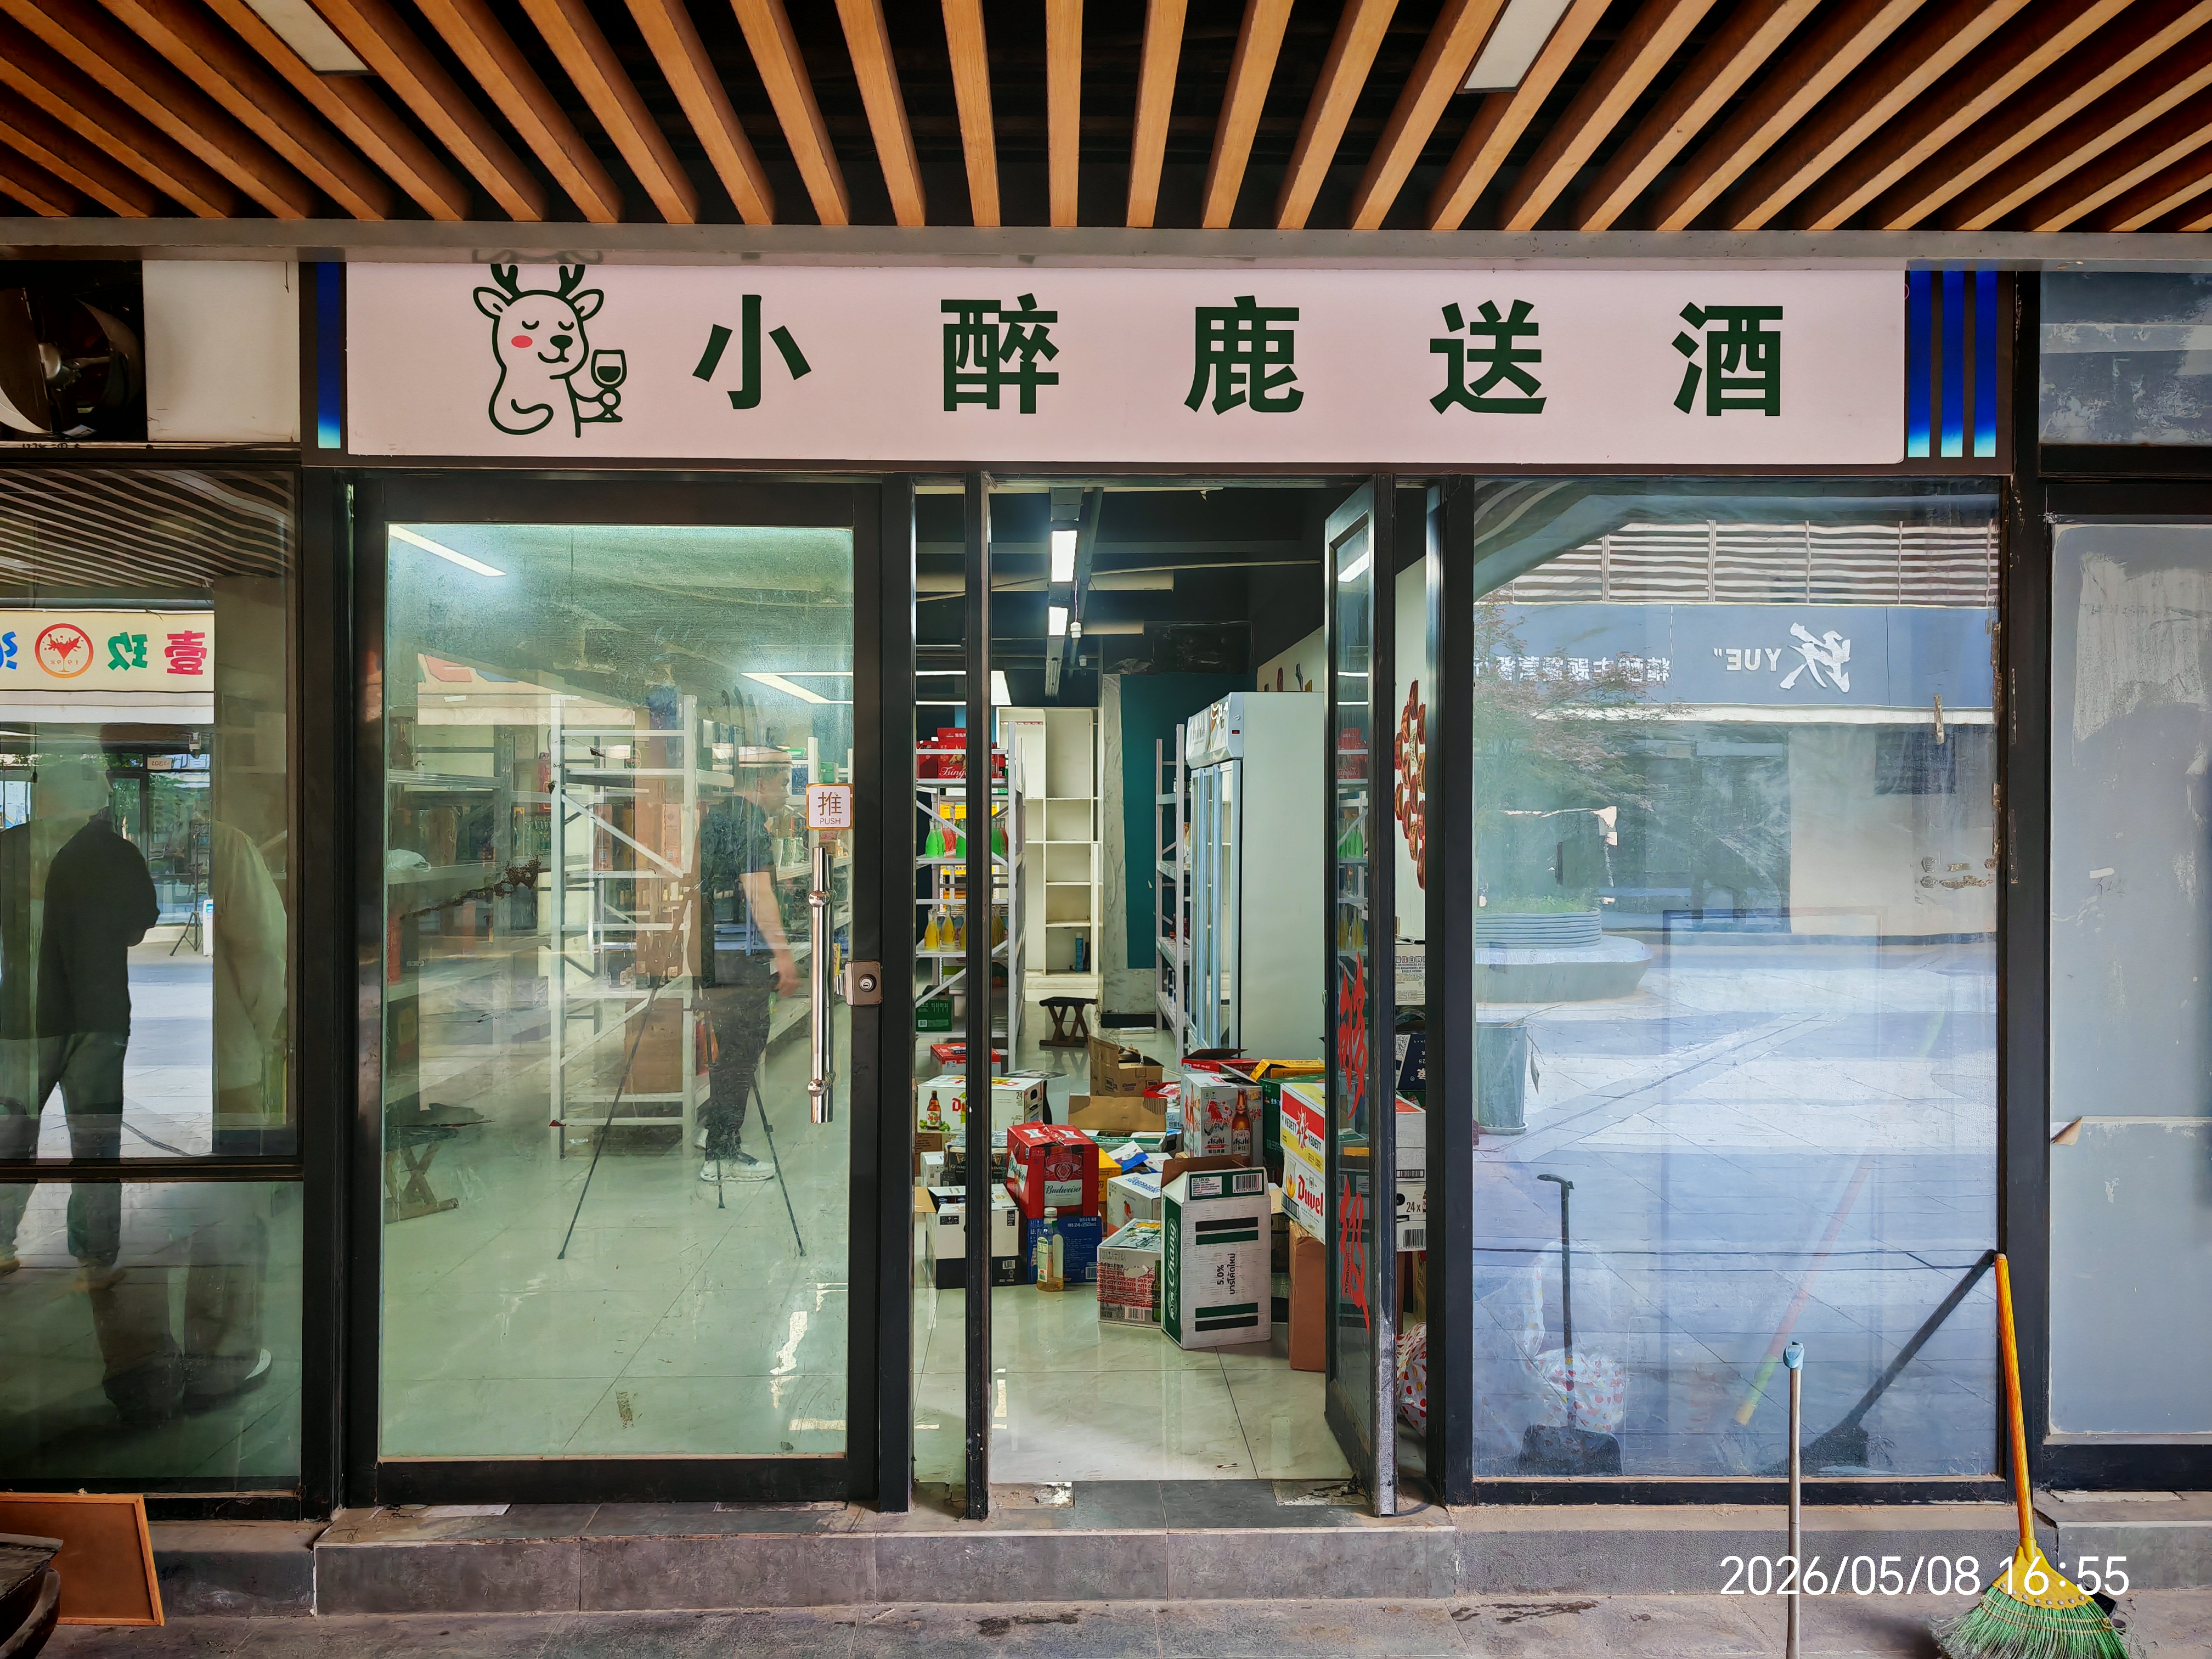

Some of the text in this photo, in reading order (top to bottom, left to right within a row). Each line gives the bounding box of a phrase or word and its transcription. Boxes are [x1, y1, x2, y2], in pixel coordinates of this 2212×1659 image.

[692, 294, 1783, 416] 小醉鹿送酒
[939, 766, 966, 779] Tsing
[817, 791, 843, 816] 推
[1284, 1116, 1297, 1134] VEDETT
[1308, 1133, 1322, 1152] VEDETT
[1045, 1184, 1081, 1194] Budweiser
[1297, 1174, 1323, 1217] Duvel
[1406, 1201, 1415, 1212] 24
[1167, 1222, 1177, 1287] Chang
